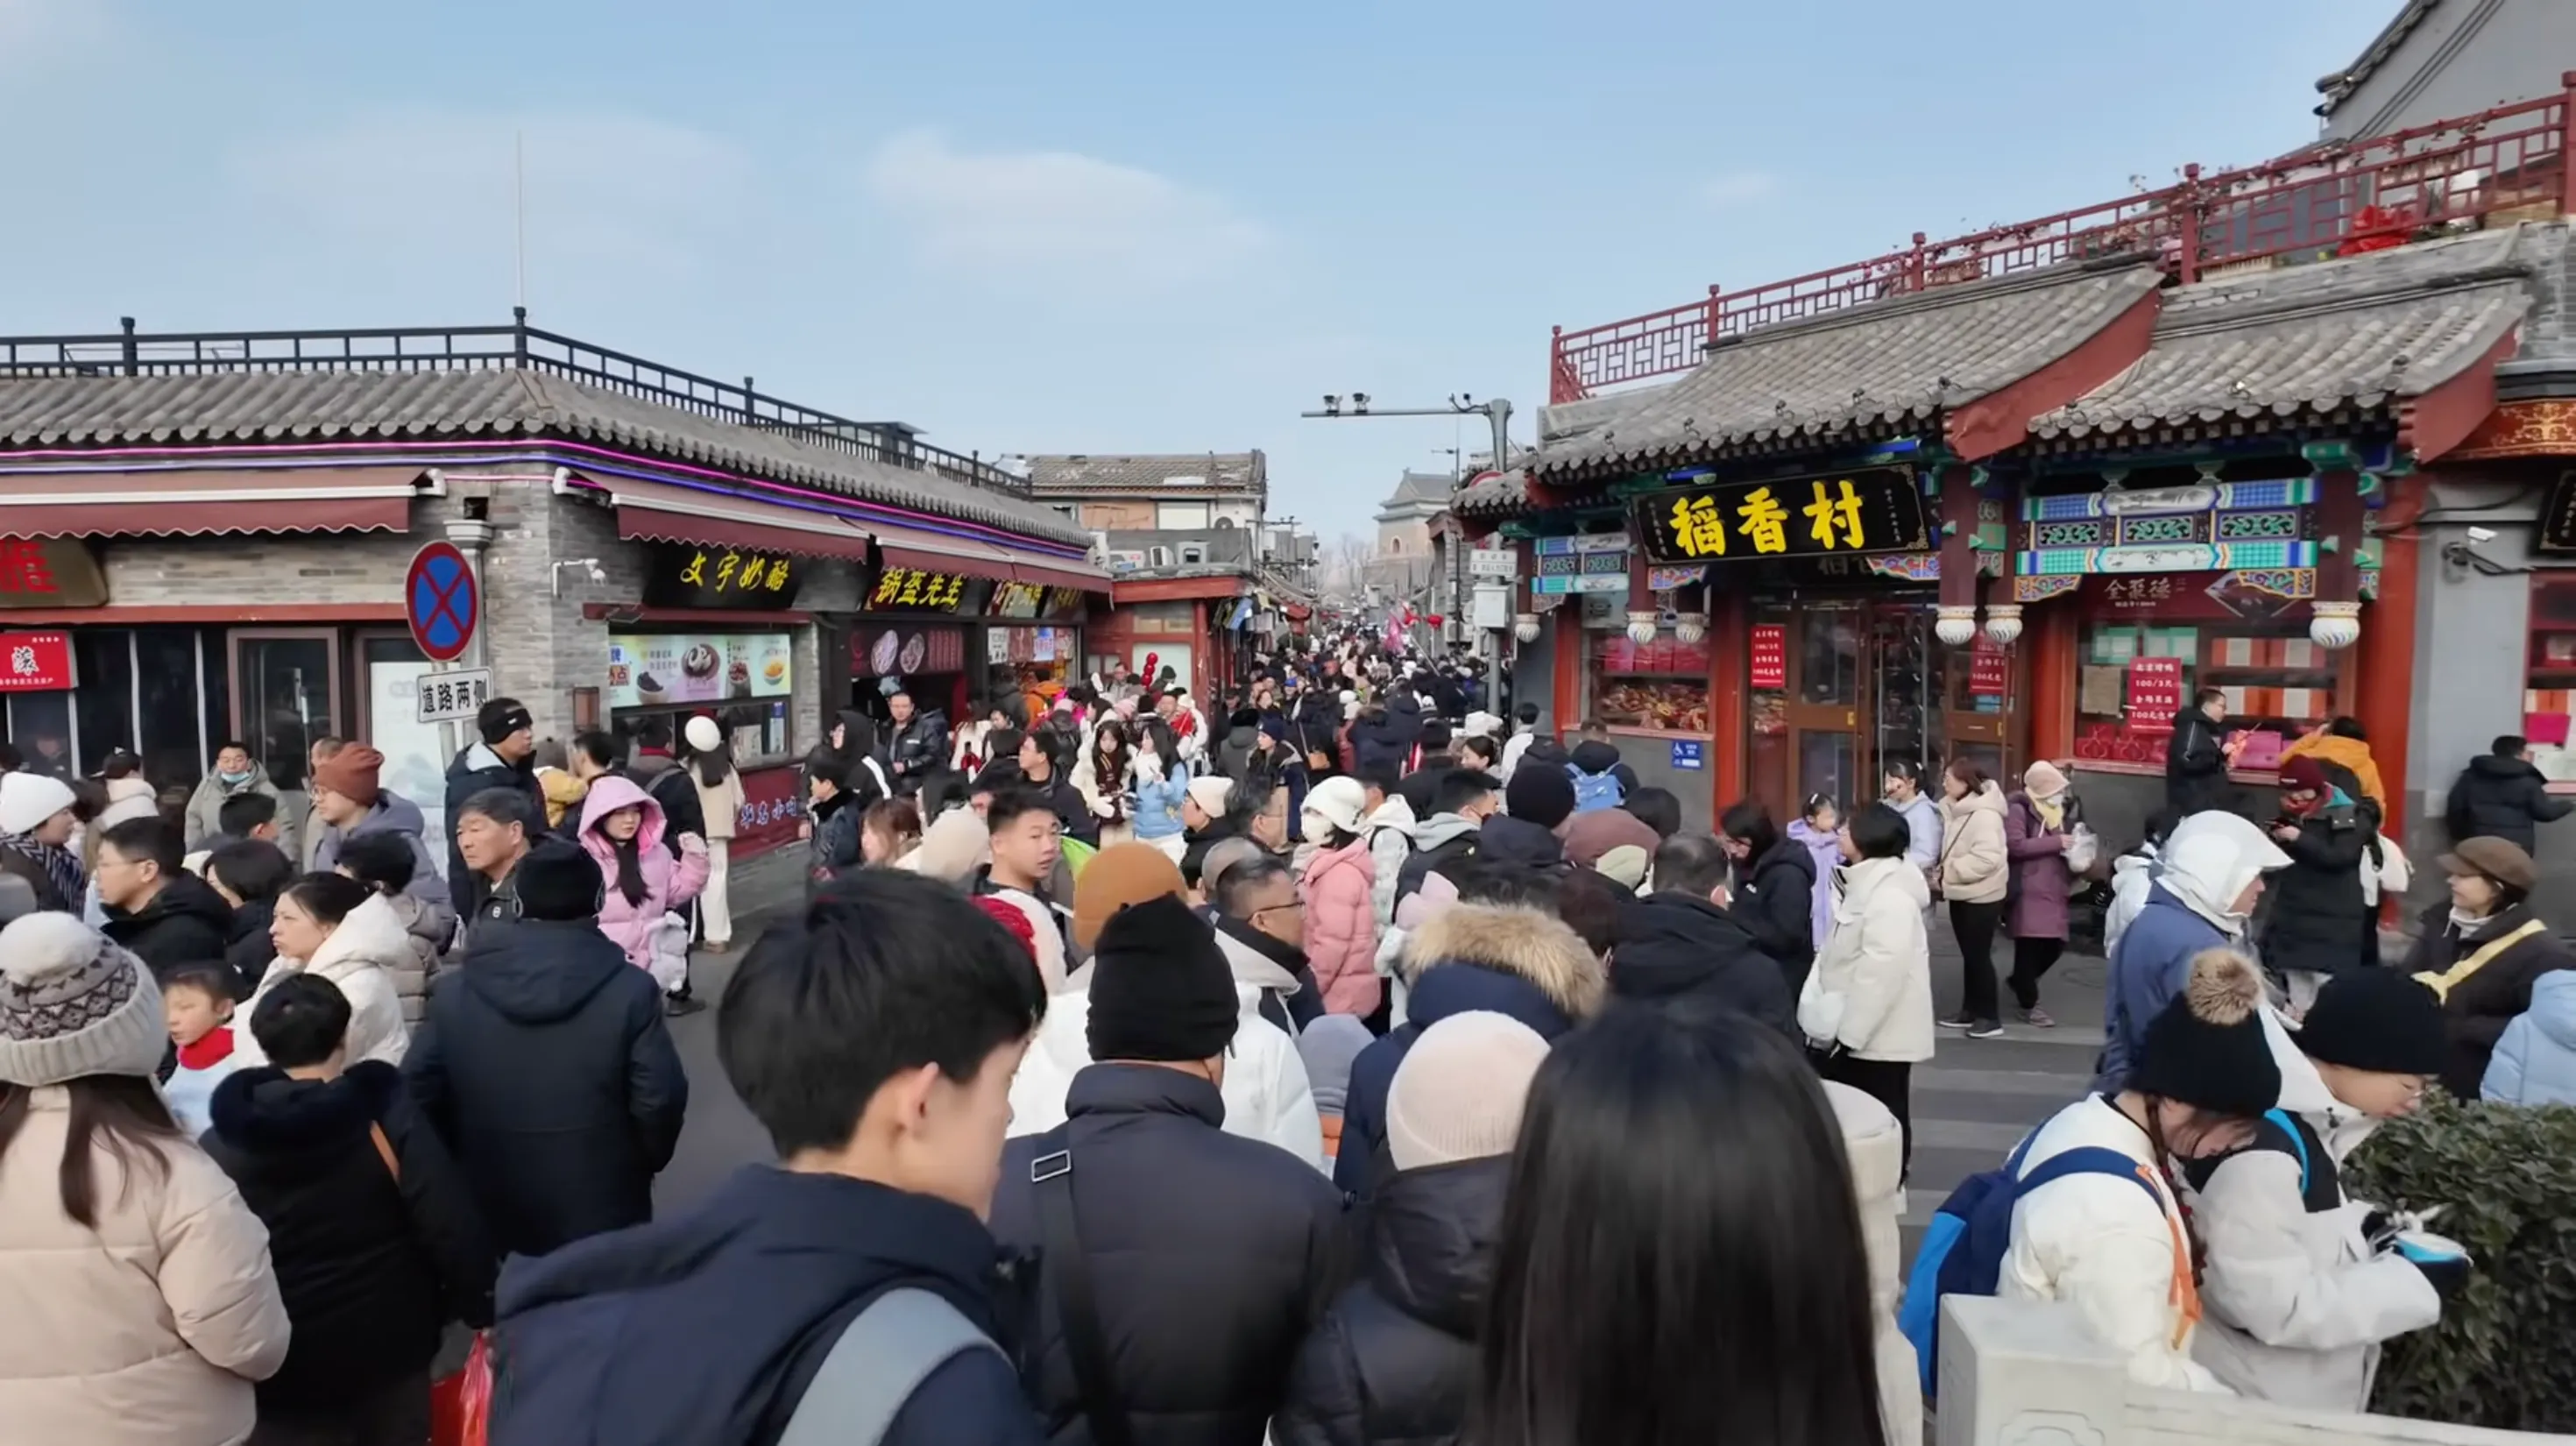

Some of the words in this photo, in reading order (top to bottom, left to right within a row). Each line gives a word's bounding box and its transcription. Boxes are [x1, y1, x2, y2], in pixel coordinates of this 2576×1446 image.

[1668, 479, 1865, 557] 稻香村
[680, 549, 789, 592] 文宇奶酪
[874, 565, 964, 606] 锅盔先生
